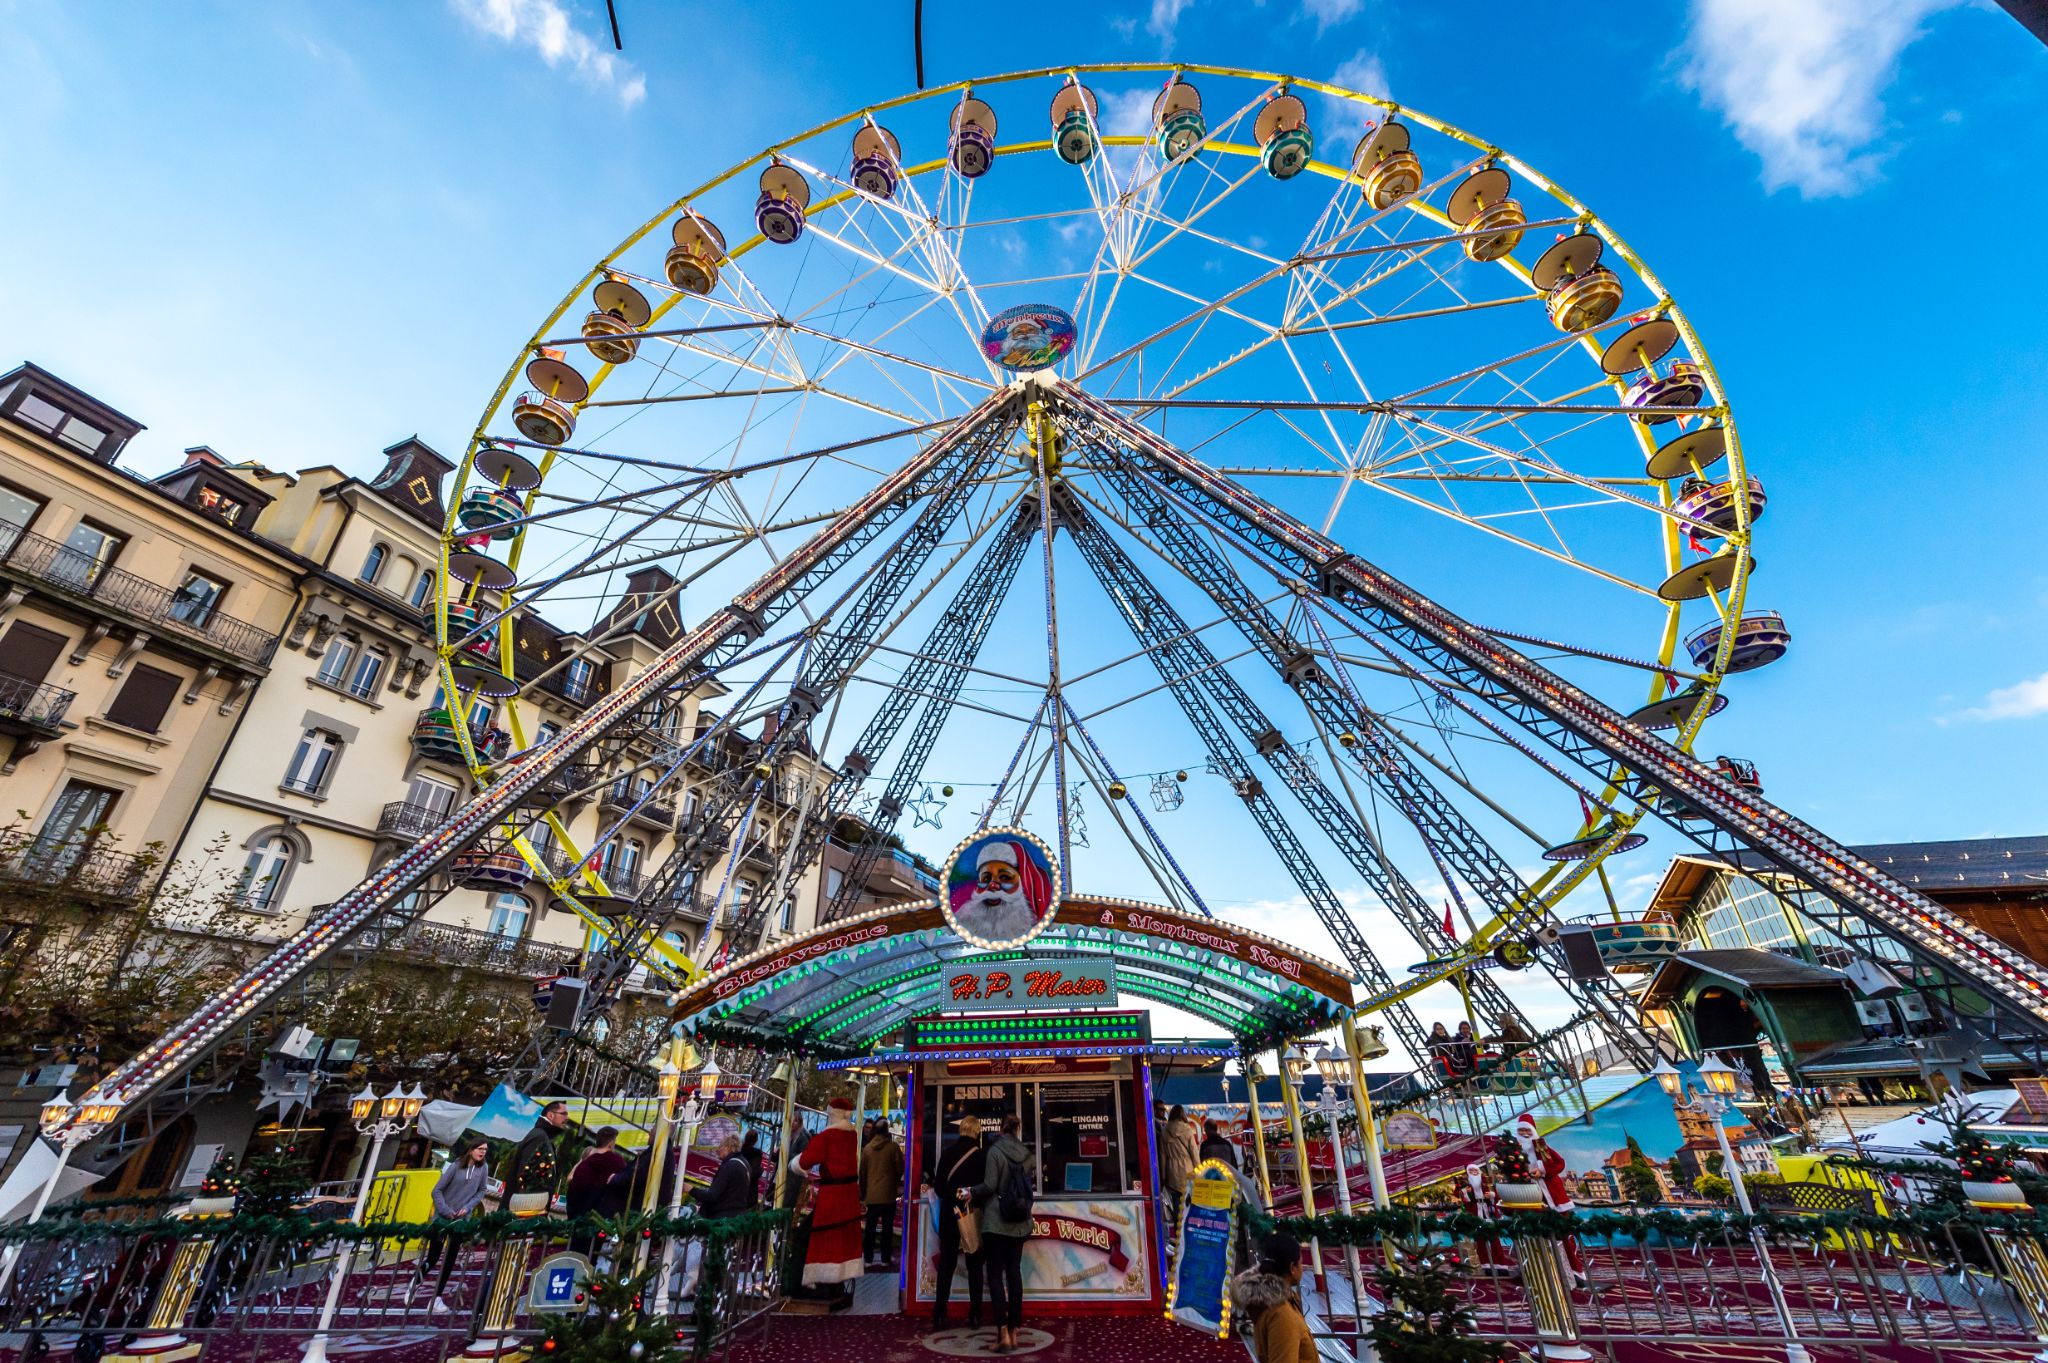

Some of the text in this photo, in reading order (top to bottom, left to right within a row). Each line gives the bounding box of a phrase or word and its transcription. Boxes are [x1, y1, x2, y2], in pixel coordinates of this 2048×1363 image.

[1101, 910, 1300, 979] à Montreux Noël
[712, 924, 889, 999] Bienvenue
[950, 970, 1107, 1000] H.P. Maier
[1072, 1115, 1109, 1123] EINGANG
[1031, 1218, 1110, 1250] he World
